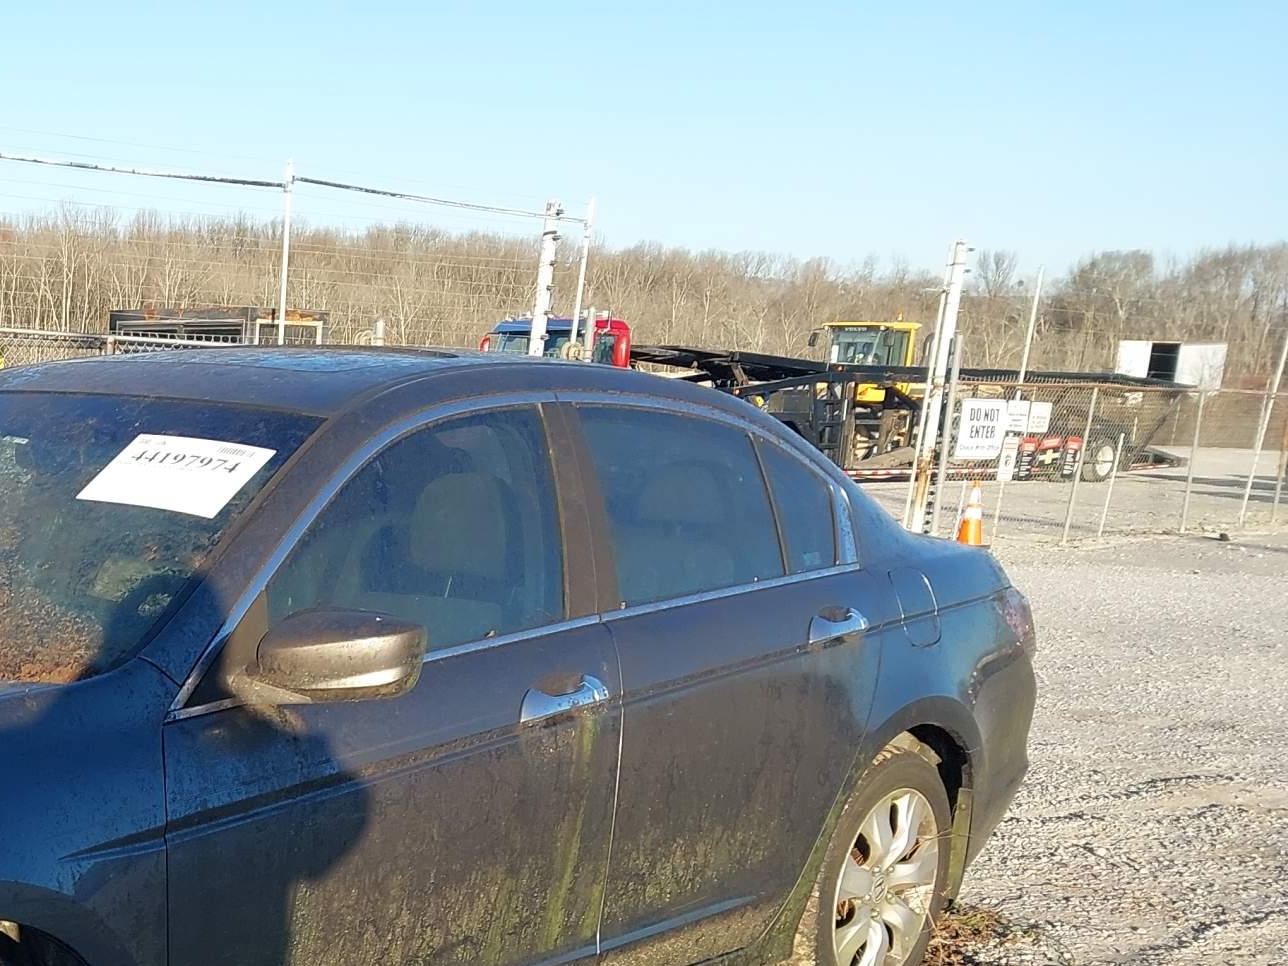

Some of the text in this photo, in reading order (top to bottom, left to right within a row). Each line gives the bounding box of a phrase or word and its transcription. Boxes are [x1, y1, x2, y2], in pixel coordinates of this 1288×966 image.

[969, 407, 1000, 422] DO NOT
[969, 424, 996, 439] ENTER
[131, 450, 241, 473] 44197974
